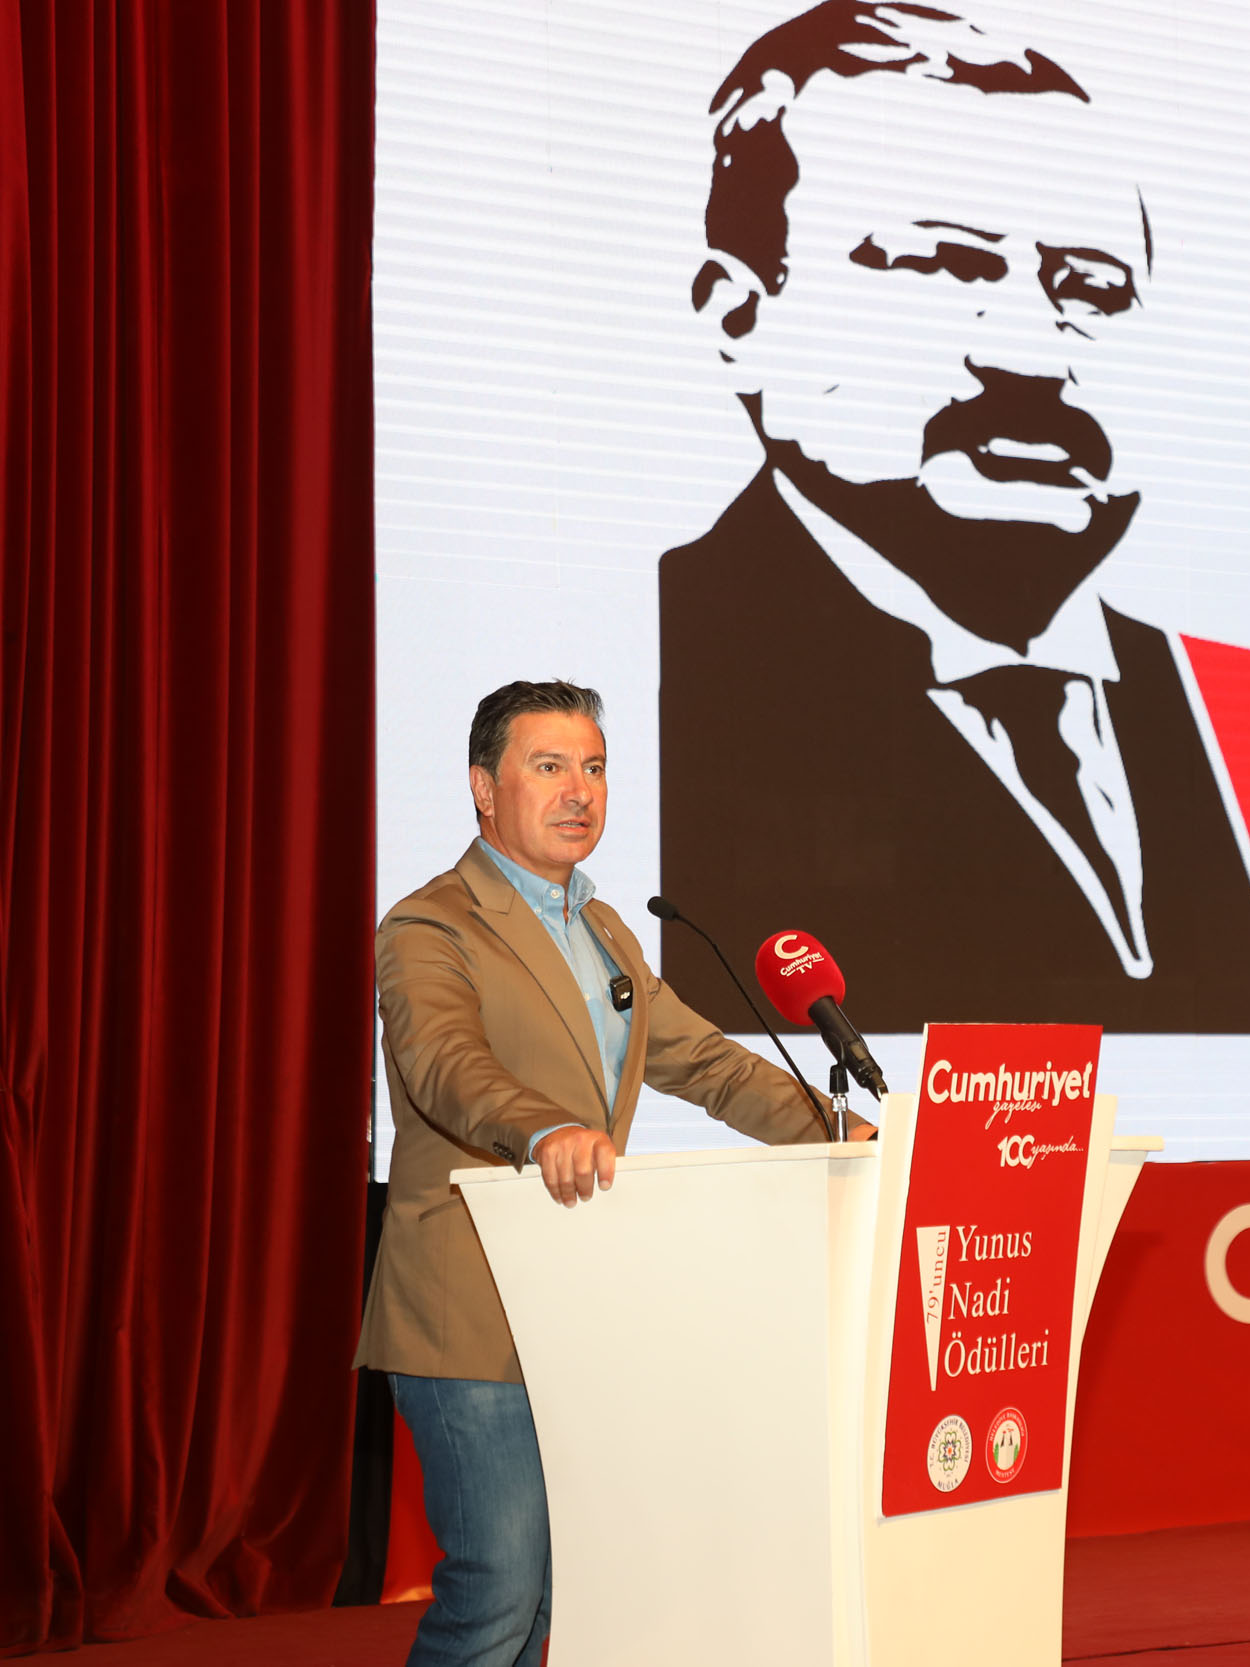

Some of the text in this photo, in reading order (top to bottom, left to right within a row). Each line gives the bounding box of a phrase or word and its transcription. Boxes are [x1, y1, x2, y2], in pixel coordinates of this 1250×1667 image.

[796, 962, 813, 974] TV
[927, 1059, 1093, 1106] Cumhuriyet
[956, 1225, 1032, 1262] Yunus
[948, 1277, 1011, 1320] Nadi
[944, 1329, 1049, 1377] Ödülleri
